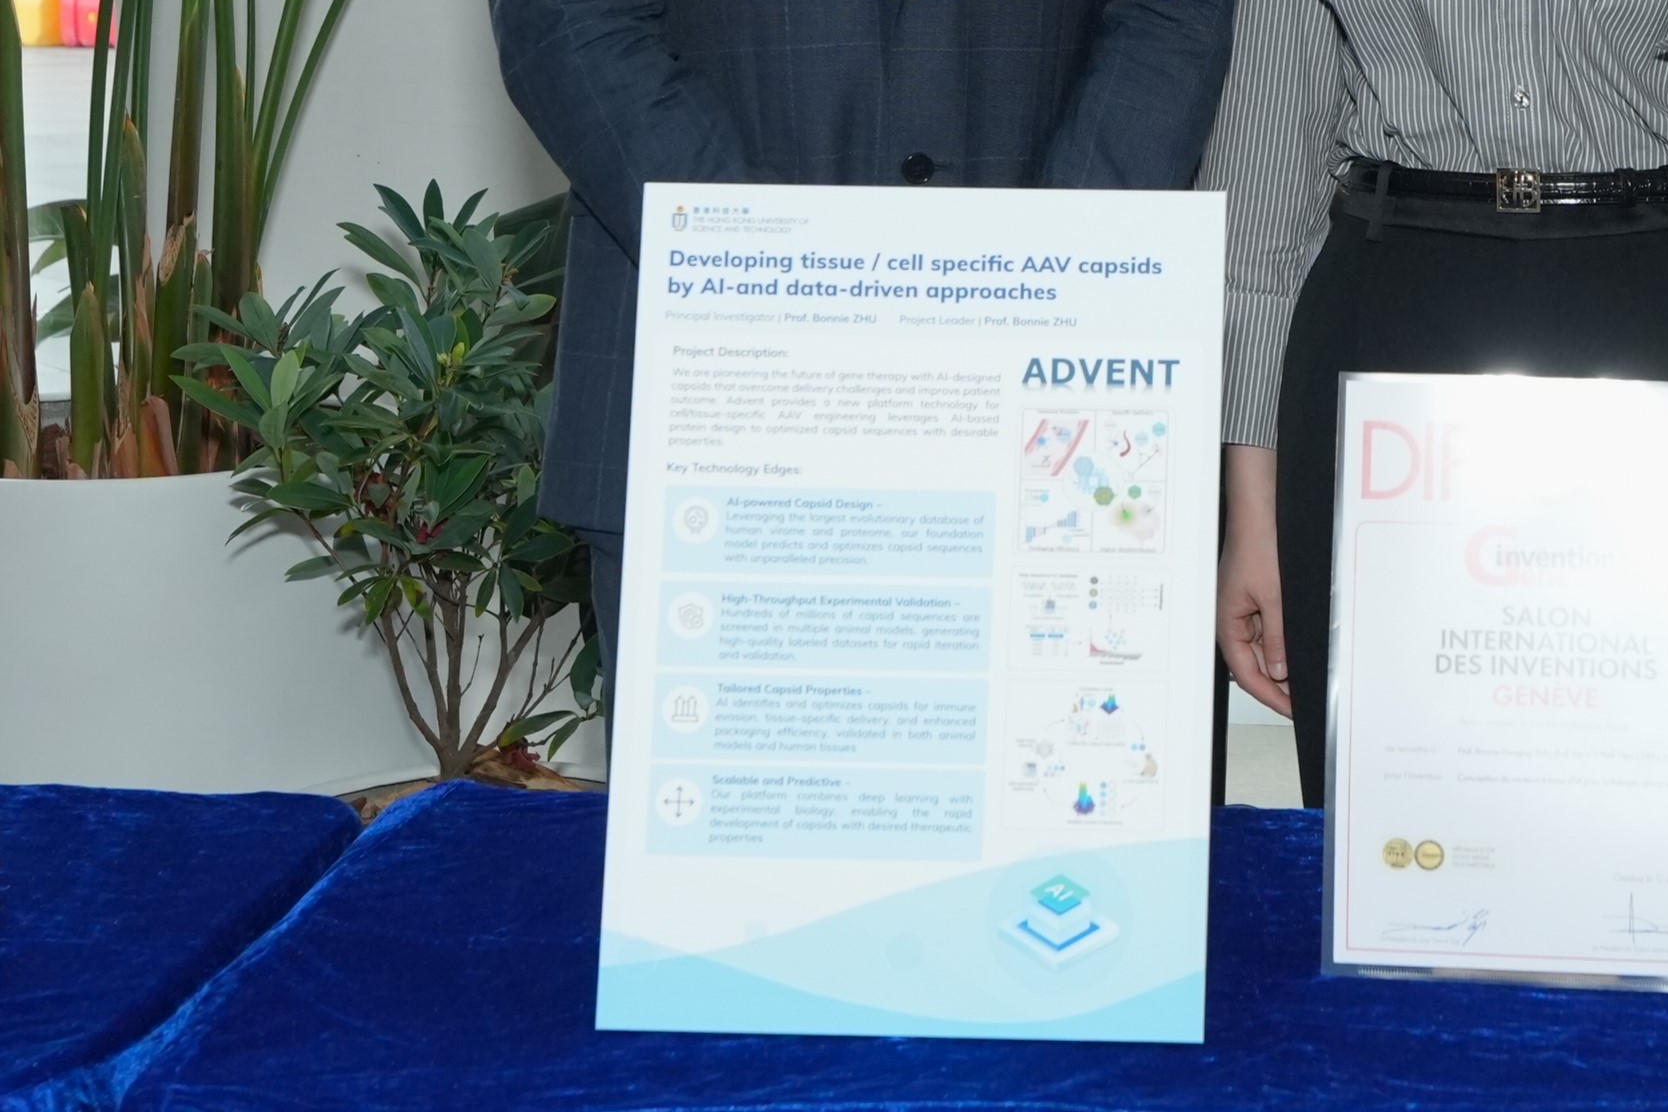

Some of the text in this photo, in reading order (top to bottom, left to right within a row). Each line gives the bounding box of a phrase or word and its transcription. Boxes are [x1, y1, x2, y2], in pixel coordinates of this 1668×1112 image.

[669, 249, 793, 273] Developing
[799, 251, 864, 269] tissue
[887, 253, 923, 270] cell
[930, 253, 1014, 277] specific
[1021, 256, 1071, 273] AAV
[1078, 255, 1162, 279] capsids
[668, 276, 1056, 304] by AI-and data-driven approaches
[665, 310, 877, 324] Principal Investigator Prof. Bonnie ZHU
[899, 314, 1077, 327] Project Leader Prof. Bonnie ZHU
[673, 345, 787, 359] Project Description:
[672, 367, 1001, 384] We are pioneering the future of gene therapy with AI-designed
[1022, 357, 1180, 386] ADVENT
[668, 423, 999, 437] protein design to optimized capsid sequences with desirable
[666, 462, 802, 477] Key Technology Edges:
[726, 497, 873, 511] AI-powered Capsid Design
[726, 511, 983, 526] Leveraging the largest evolutionary database of
[722, 593, 951, 608] High-Throughput Experimental Validation
[1500, 605, 1591, 628] SALON
[719, 635, 979, 651] high-quality labeled datasets for rapid iteration
[1437, 628, 1654, 654] INTERNATIONAL
[1434, 654, 1658, 680] DES INVENTIONS
[717, 683, 862, 697] Tailored Capsid Properties
[714, 725, 976, 741] packaging efficiency, validated in both animal
[712, 774, 841, 787] Scalable and Predictive
[709, 817, 970, 834] development of capsids with desired therapeutic
